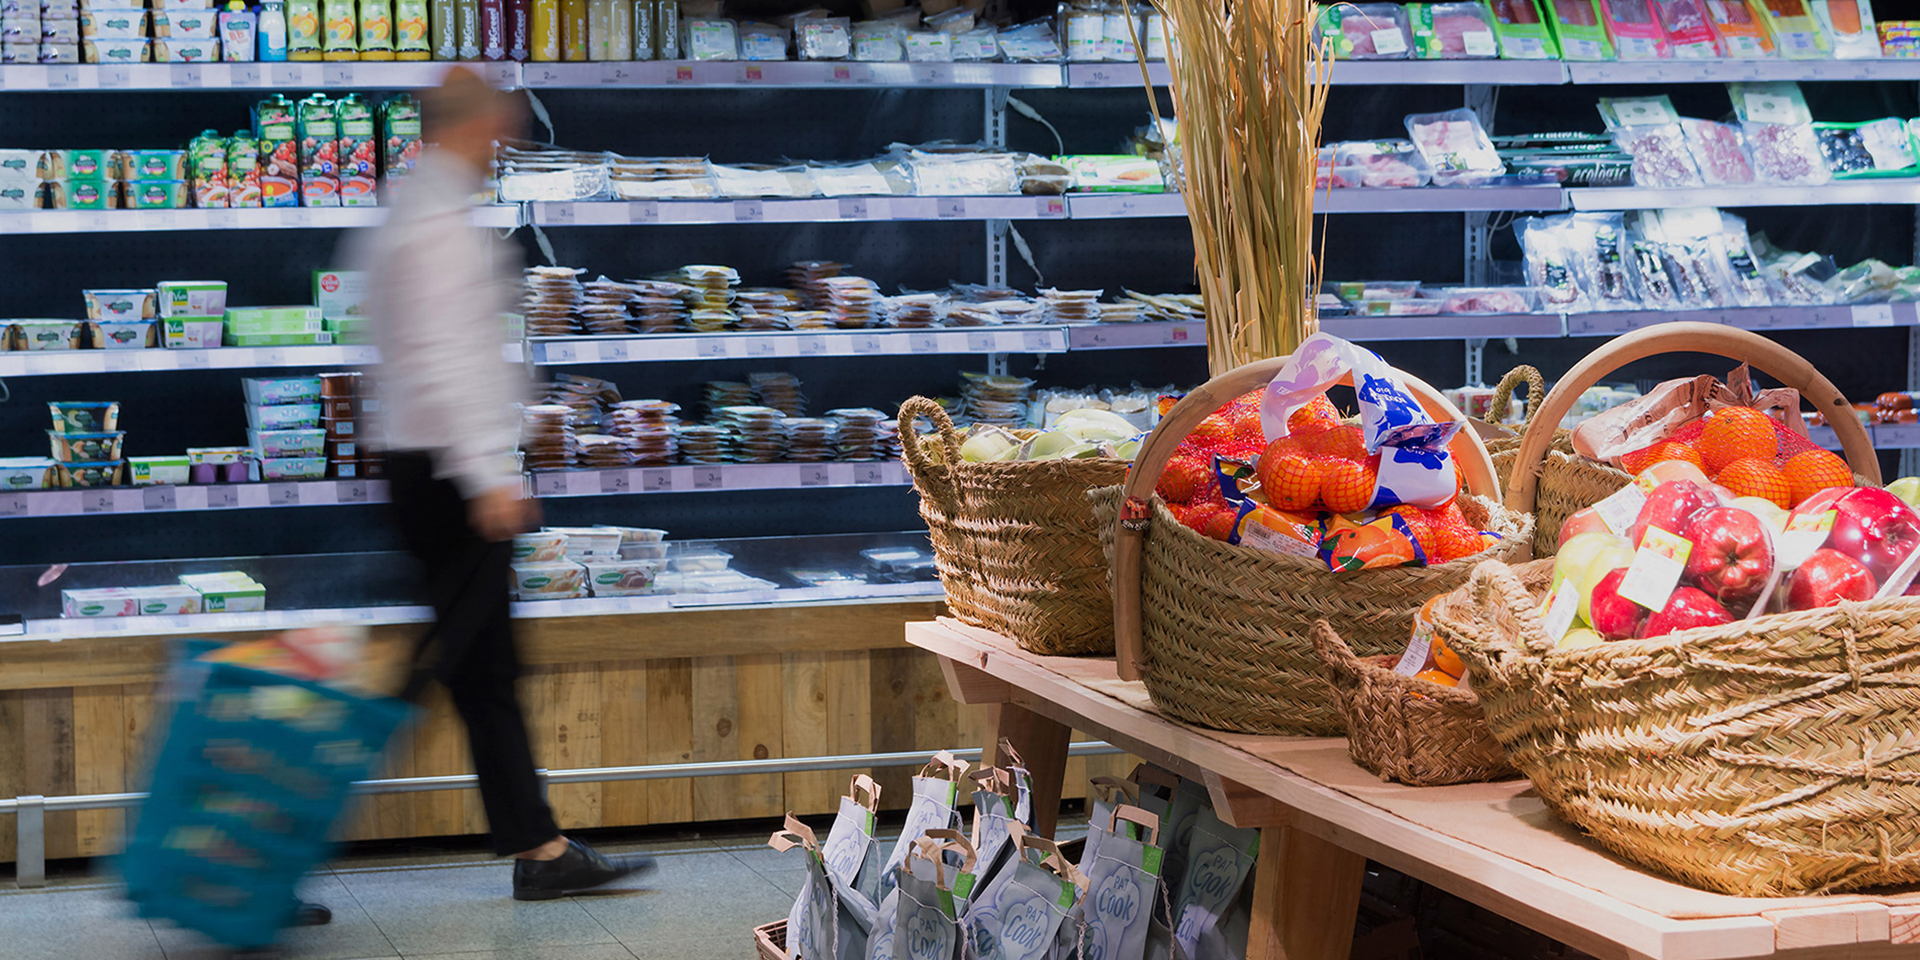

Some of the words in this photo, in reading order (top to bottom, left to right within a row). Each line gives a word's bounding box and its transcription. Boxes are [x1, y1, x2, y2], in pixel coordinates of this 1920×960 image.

[1213, 855, 1233, 872] PAT
[1113, 875, 1130, 892] PAT
[1025, 905, 1044, 923] PAT
[919, 917, 938, 933] PAT
